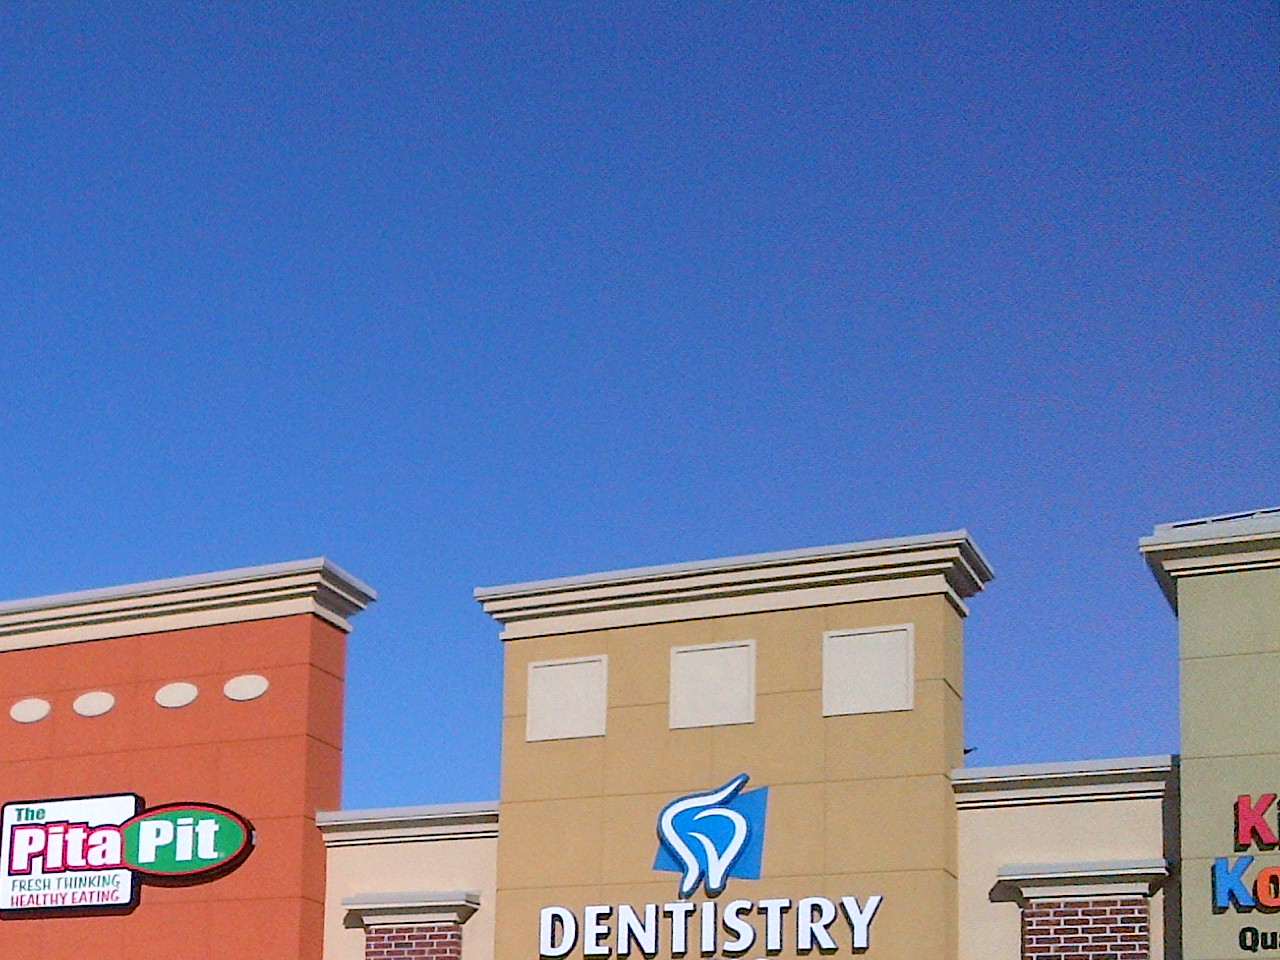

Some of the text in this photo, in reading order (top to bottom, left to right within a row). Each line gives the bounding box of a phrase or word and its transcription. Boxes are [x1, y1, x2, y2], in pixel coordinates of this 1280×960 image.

[16, 808, 45, 821] The
[9, 818, 220, 874] Pita Pit
[12, 874, 121, 892] FRESH THINKING
[11, 889, 120, 907] HEALTHY EATING
[539, 895, 883, 960] DENTISTRY
